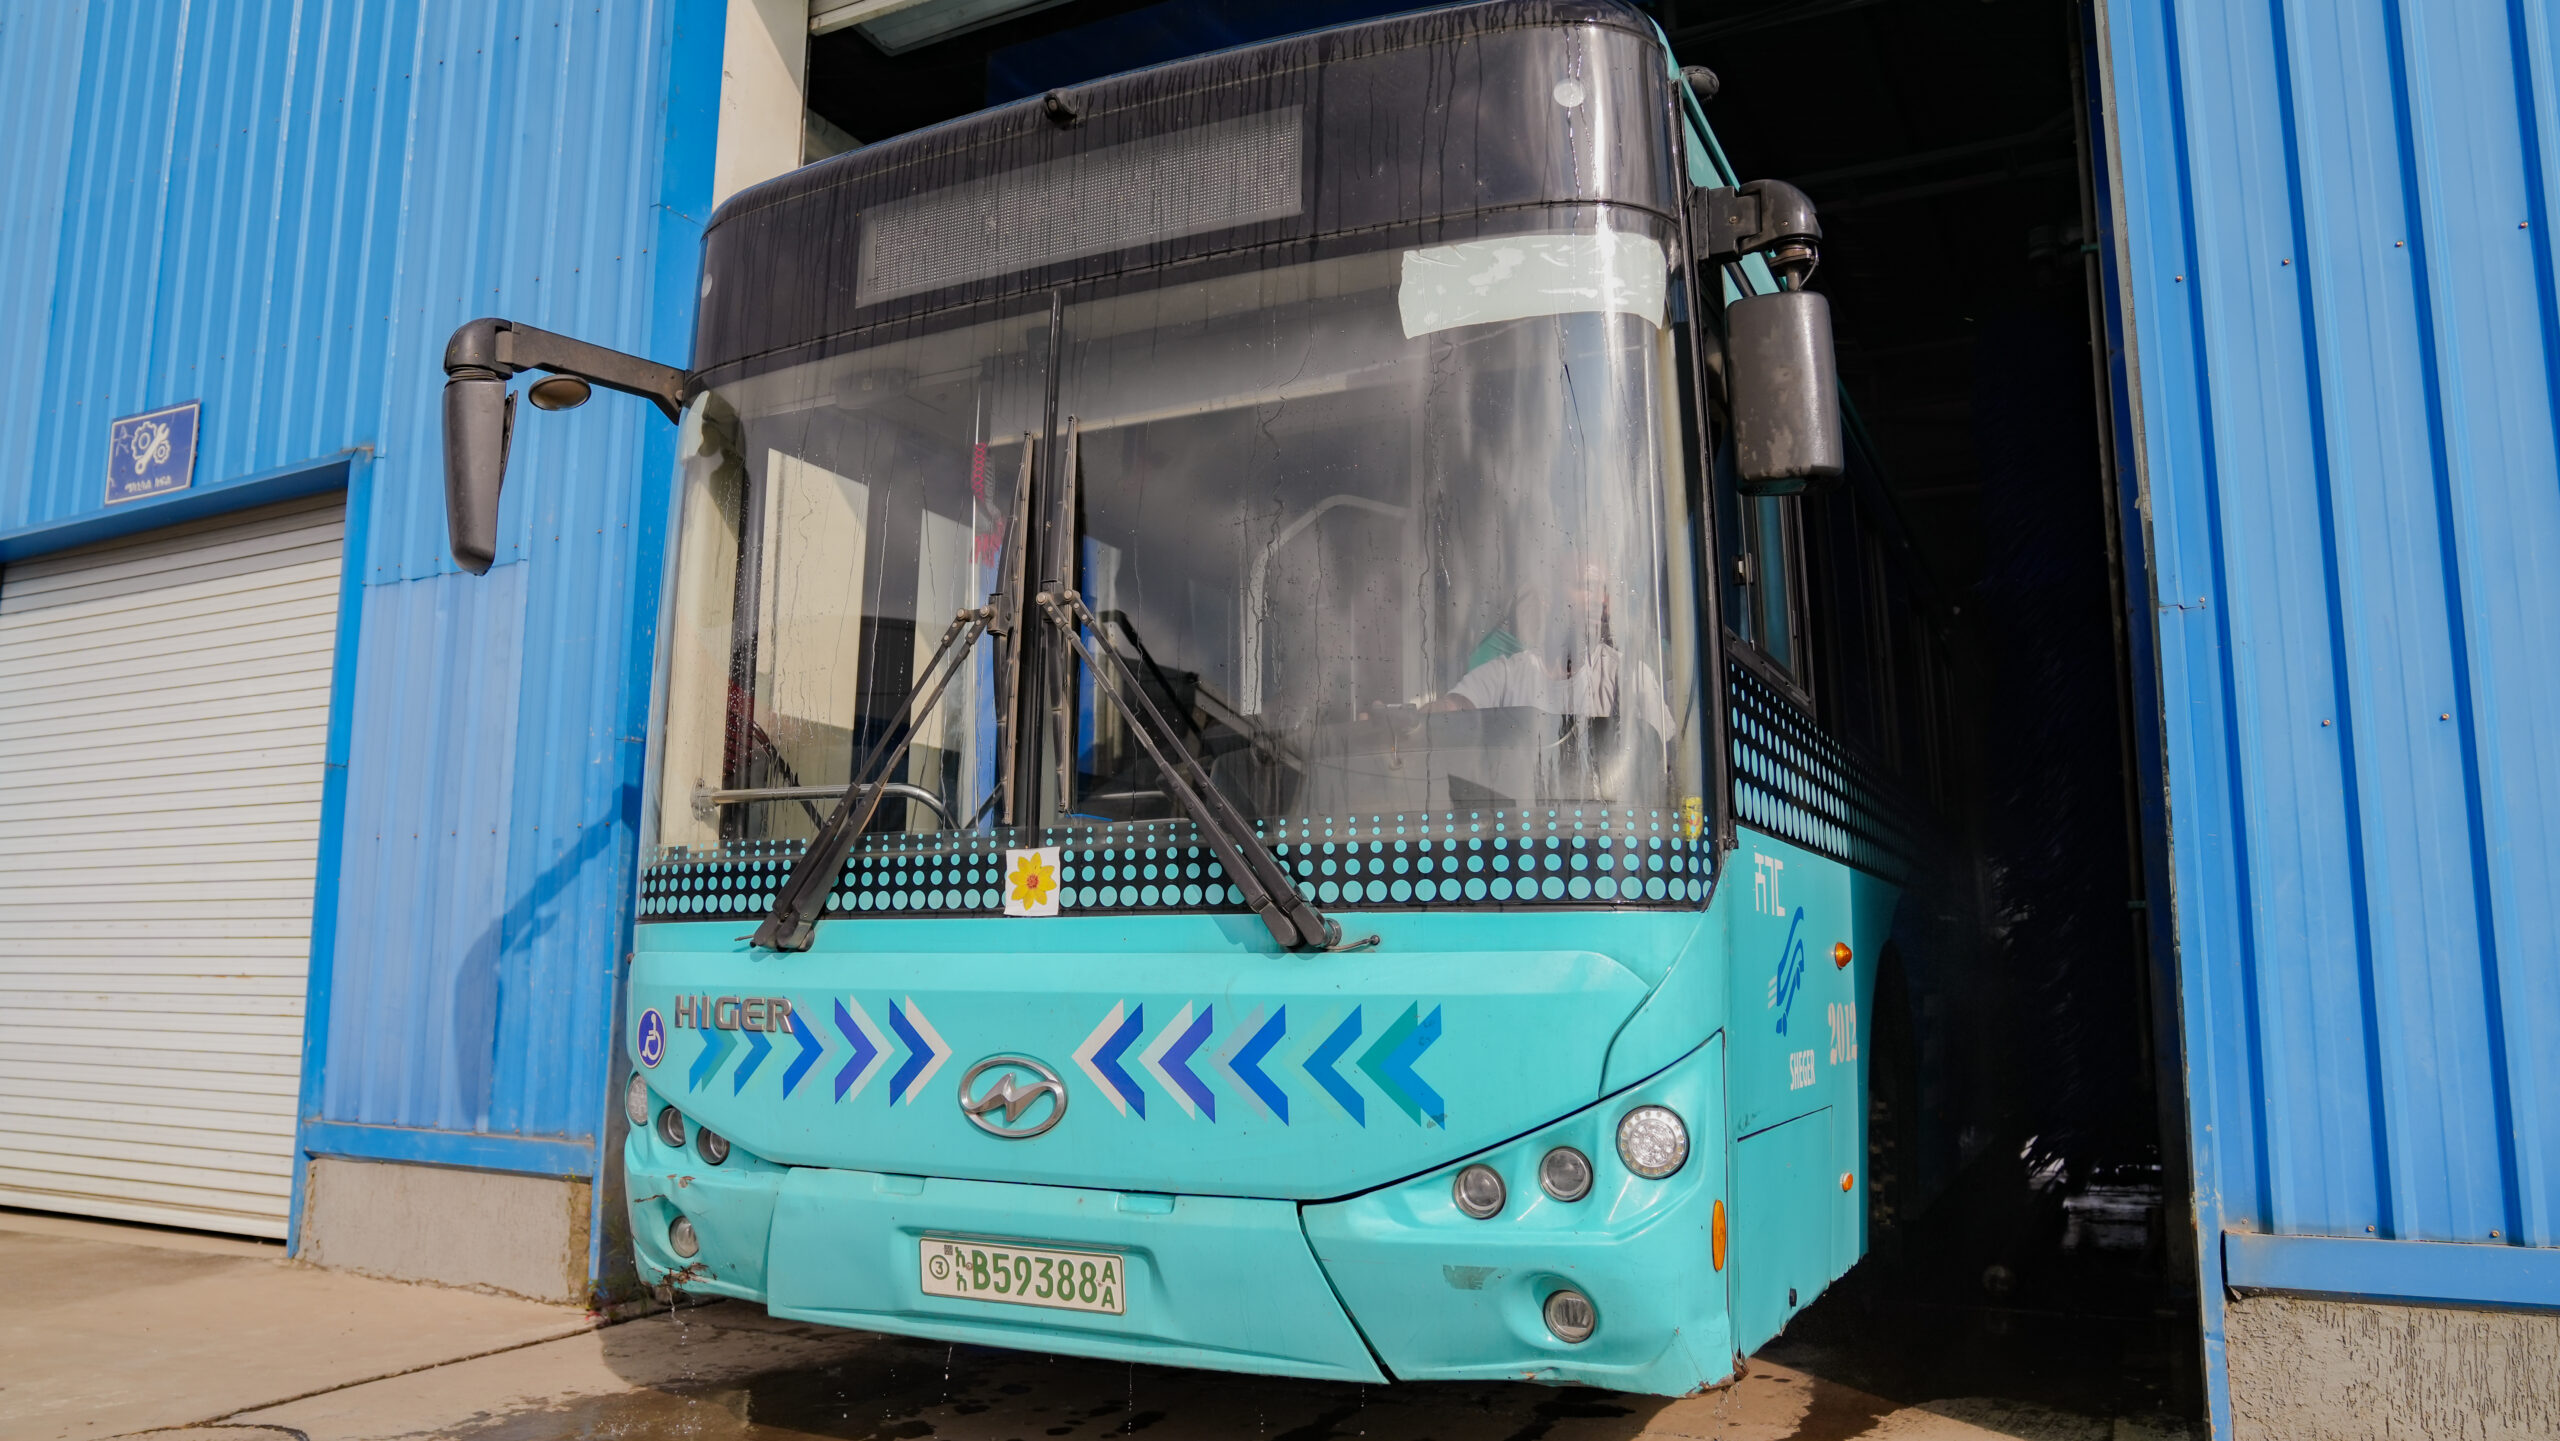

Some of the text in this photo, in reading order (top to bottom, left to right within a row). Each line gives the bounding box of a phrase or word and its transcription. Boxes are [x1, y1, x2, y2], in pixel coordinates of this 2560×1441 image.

[675, 995, 793, 1034] HIGER
[1828, 1001, 1858, 1066] 2012
[1789, 1049, 1816, 1091] SHEGER
[971, 1249, 1098, 1304] B59388
